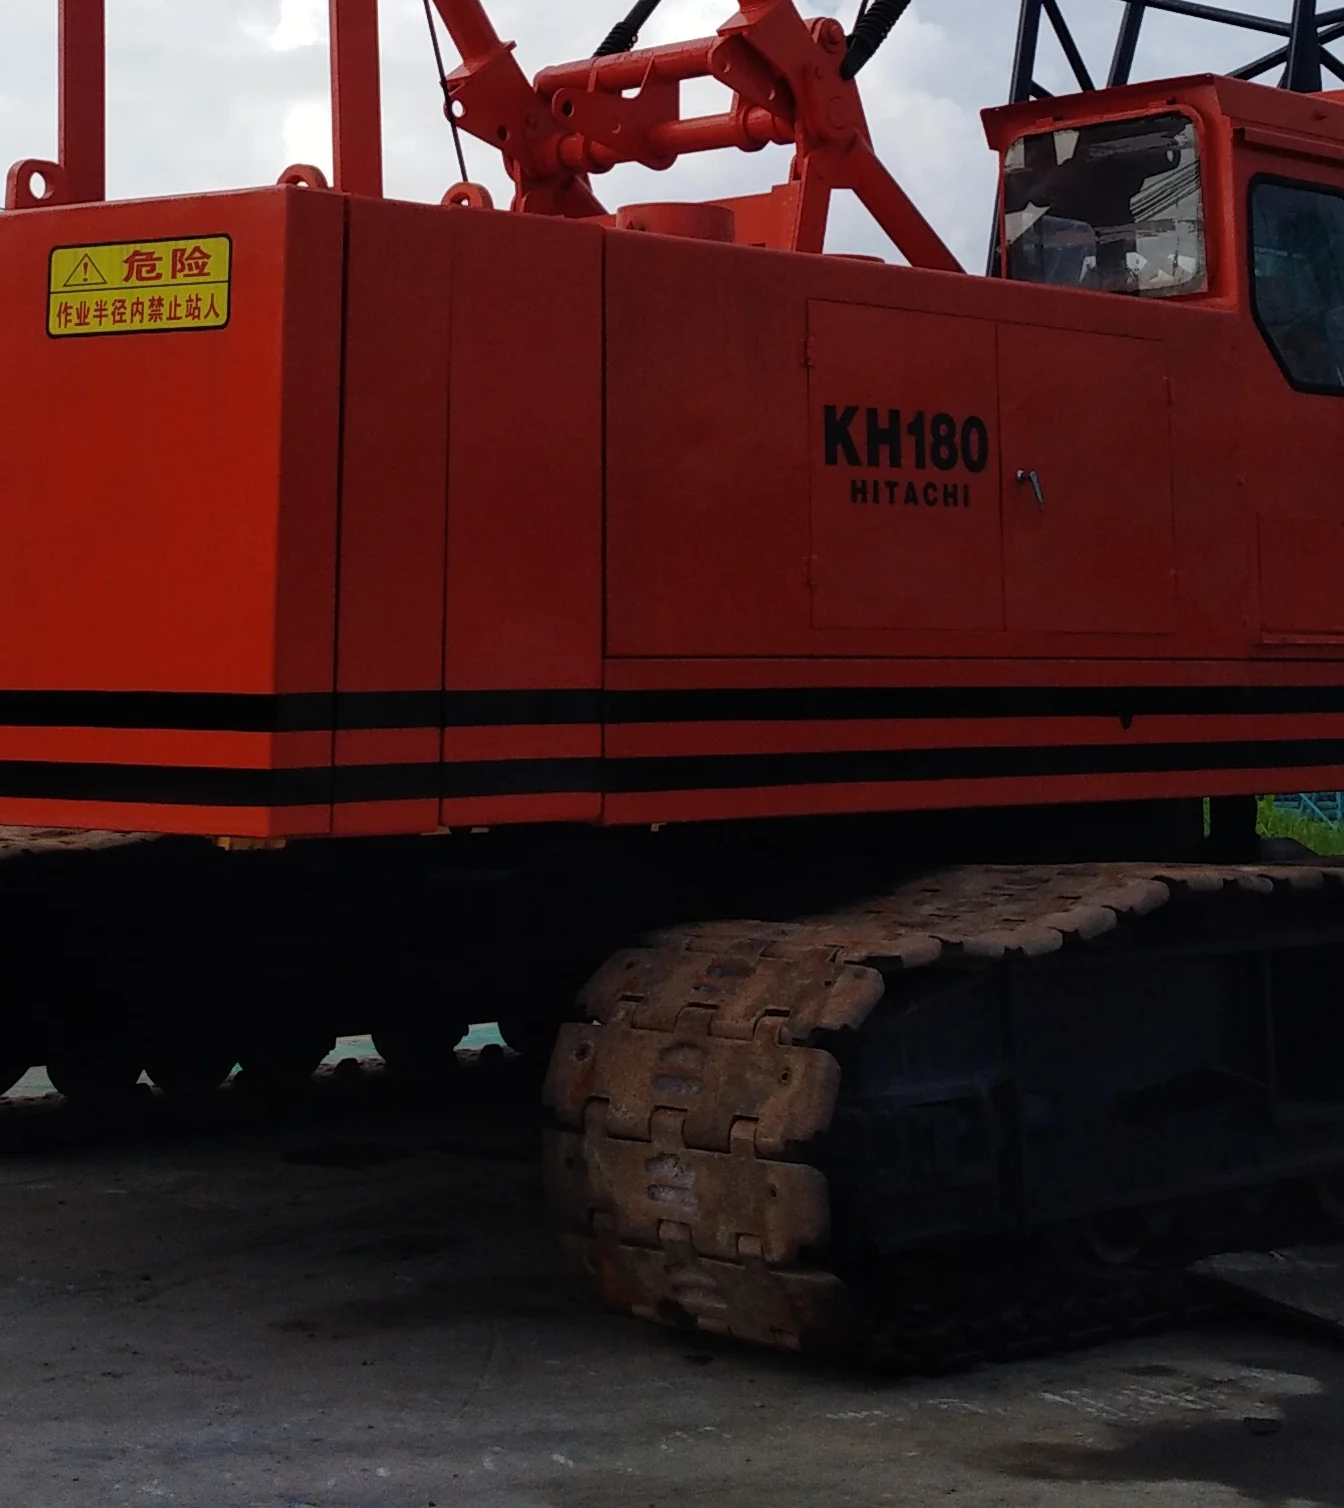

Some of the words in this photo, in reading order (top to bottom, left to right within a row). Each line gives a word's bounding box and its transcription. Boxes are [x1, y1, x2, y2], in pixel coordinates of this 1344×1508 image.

[122, 246, 212, 283] 危险
[56, 292, 221, 329] 作业半径内禁止站人
[823, 404, 989, 474] KH180
[850, 479, 971, 509] HITACHI
